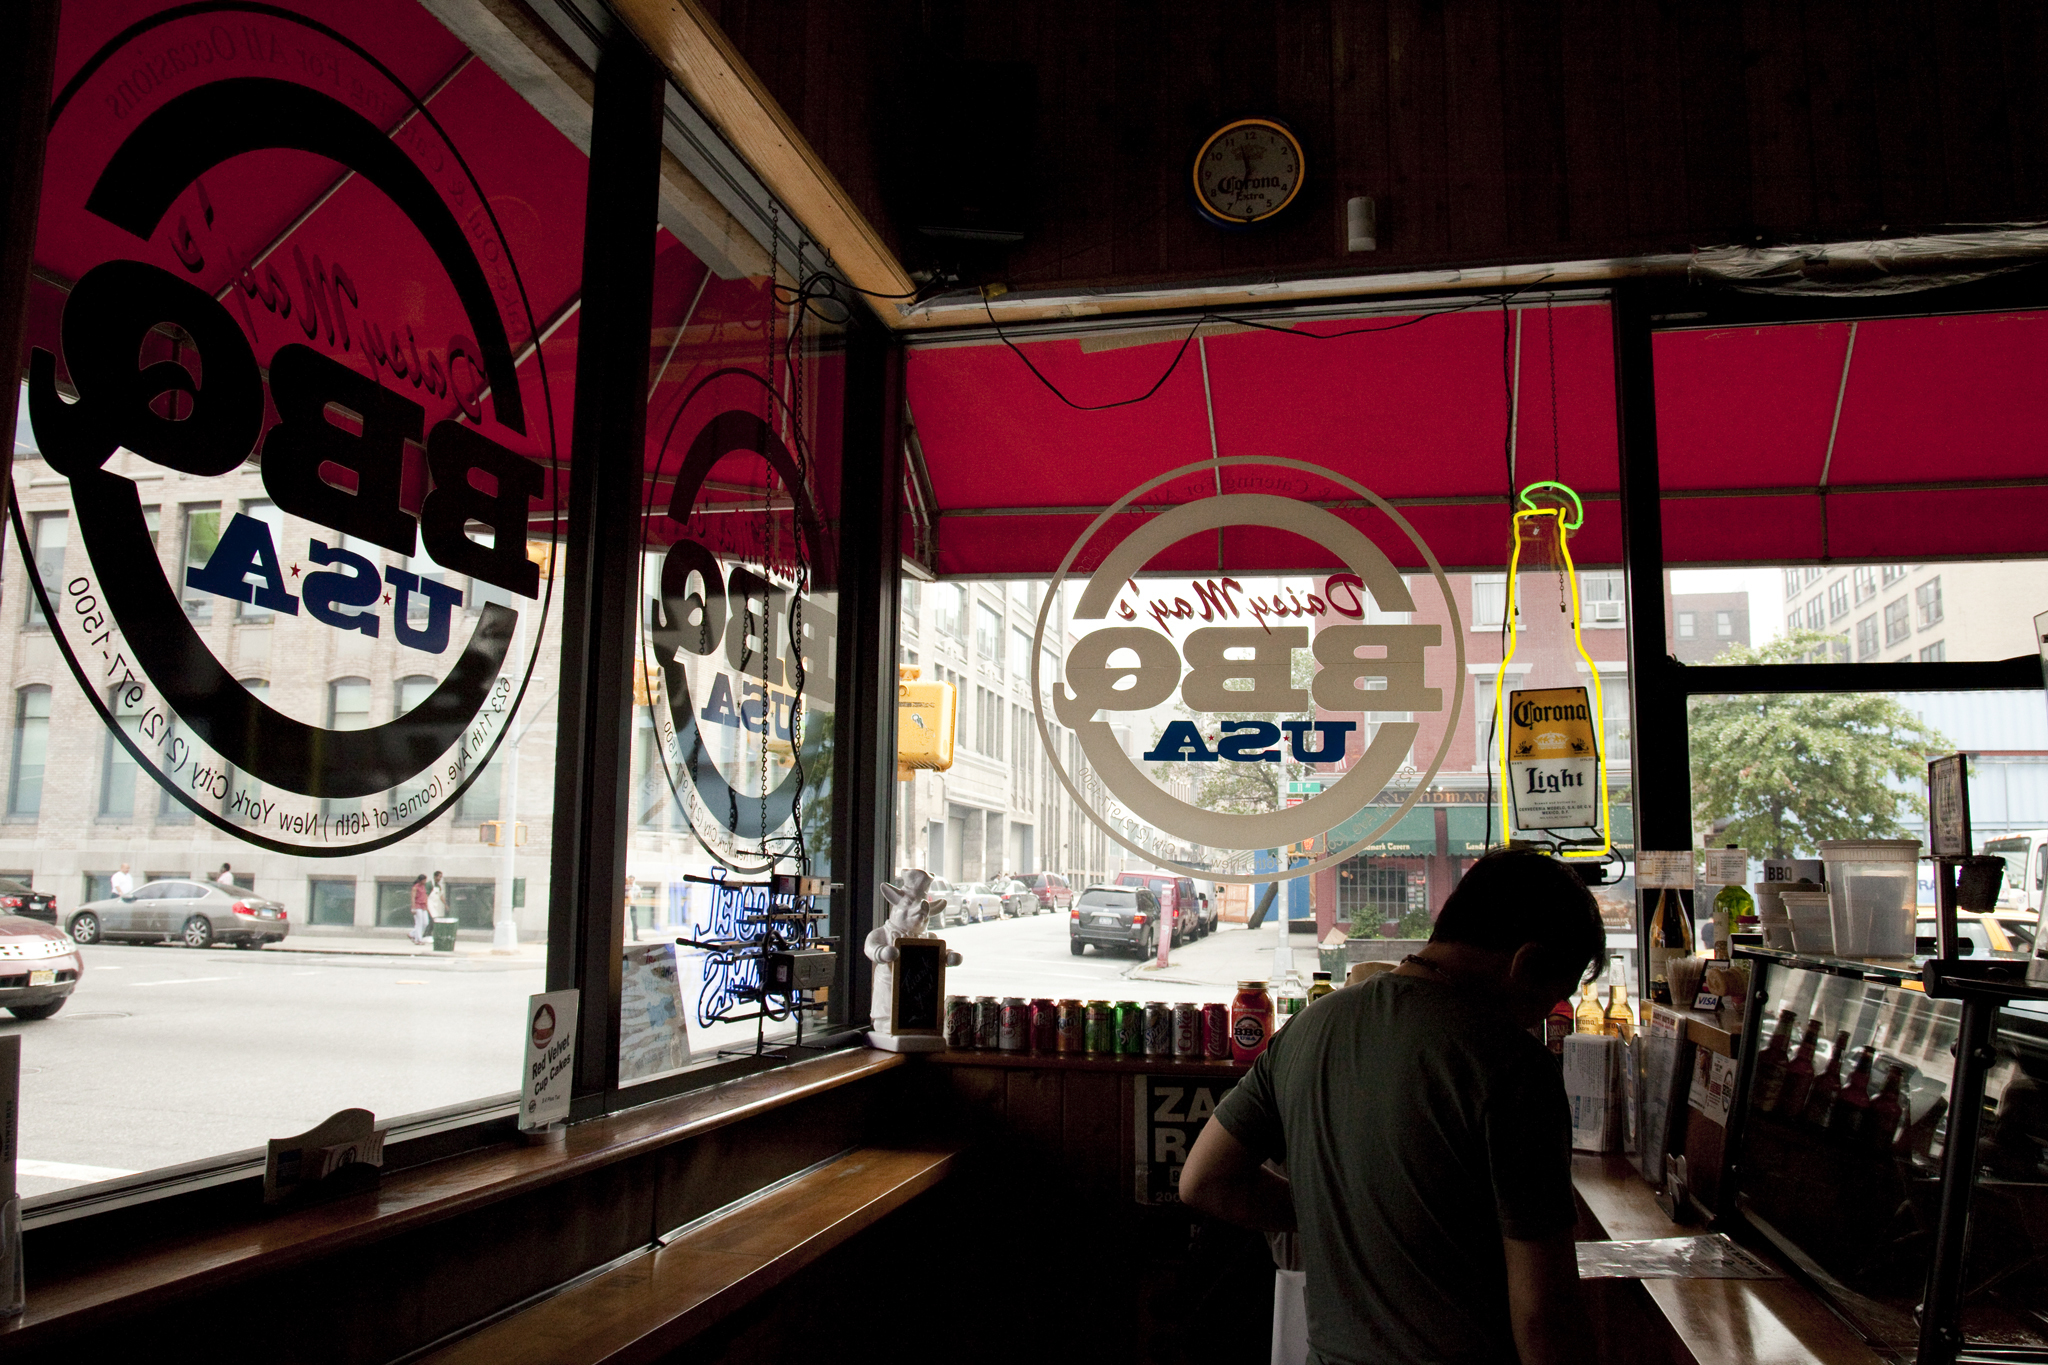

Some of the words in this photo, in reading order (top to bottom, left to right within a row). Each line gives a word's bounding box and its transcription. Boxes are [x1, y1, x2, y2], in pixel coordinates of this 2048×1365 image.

[1245, 131, 1257, 140] 12
[1270, 136, 1275, 144] 1
[1225, 139, 1236, 147] 11
[1281, 146, 1288, 155] 2
[1210, 152, 1223, 161] 10
[1286, 164, 1293, 173] 3
[1204, 171, 1212, 180] 9
[1217, 175, 1281, 197] Corona
[1280, 183, 1288, 192] 4
[1210, 188, 1217, 197] 8
[1236, 191, 1265, 201] Extra
[1226, 202, 1234, 211] 7
[1265, 199, 1273, 208] 5
[1245, 205, 1253, 214] 6
[1513, 700, 1588, 730] Corona
[1525, 767, 1584, 794] Light
[1393, 791, 1498, 803] LNDMARK
[1698, 996, 1717, 1006] VISA
[1577, 1018, 1595, 1026] rona
[1178, 1010, 1193, 1052] Coke
[1234, 1028, 1264, 1038] BBQ
[532, 1053, 546, 1081] Red
[547, 1032, 570, 1065] Velvet
[534, 1075, 549, 1096] Cup
[550, 1053, 572, 1081] Cakes
[1155, 1191, 1181, 1204] 200
